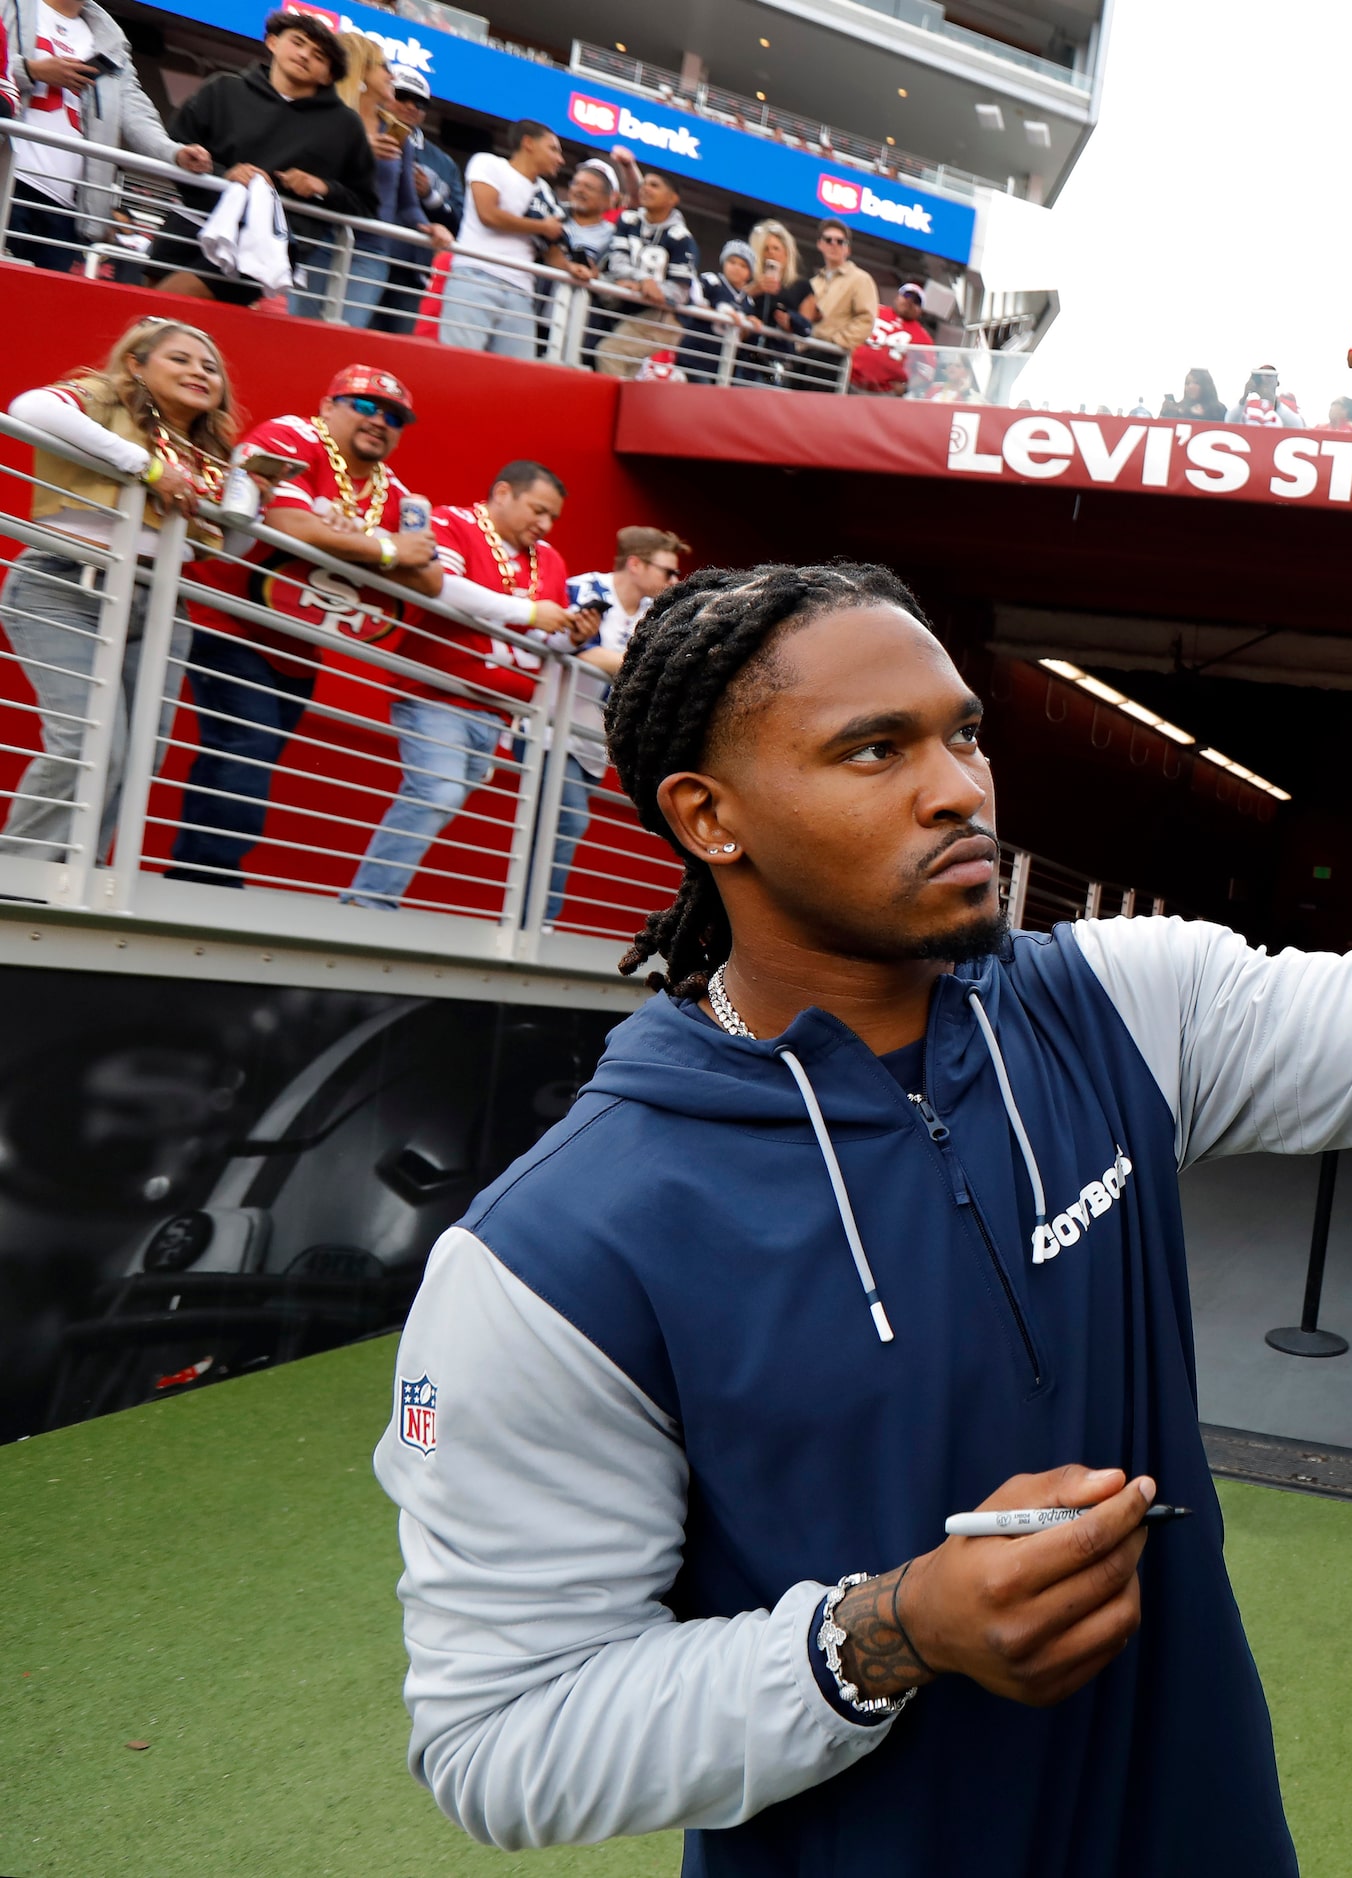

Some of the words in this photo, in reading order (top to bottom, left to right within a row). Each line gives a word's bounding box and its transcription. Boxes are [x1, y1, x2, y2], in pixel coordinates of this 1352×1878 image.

[573, 99, 615, 131] us
[617, 107, 701, 160] bank
[821, 180, 858, 210] us
[860, 186, 935, 234] bank
